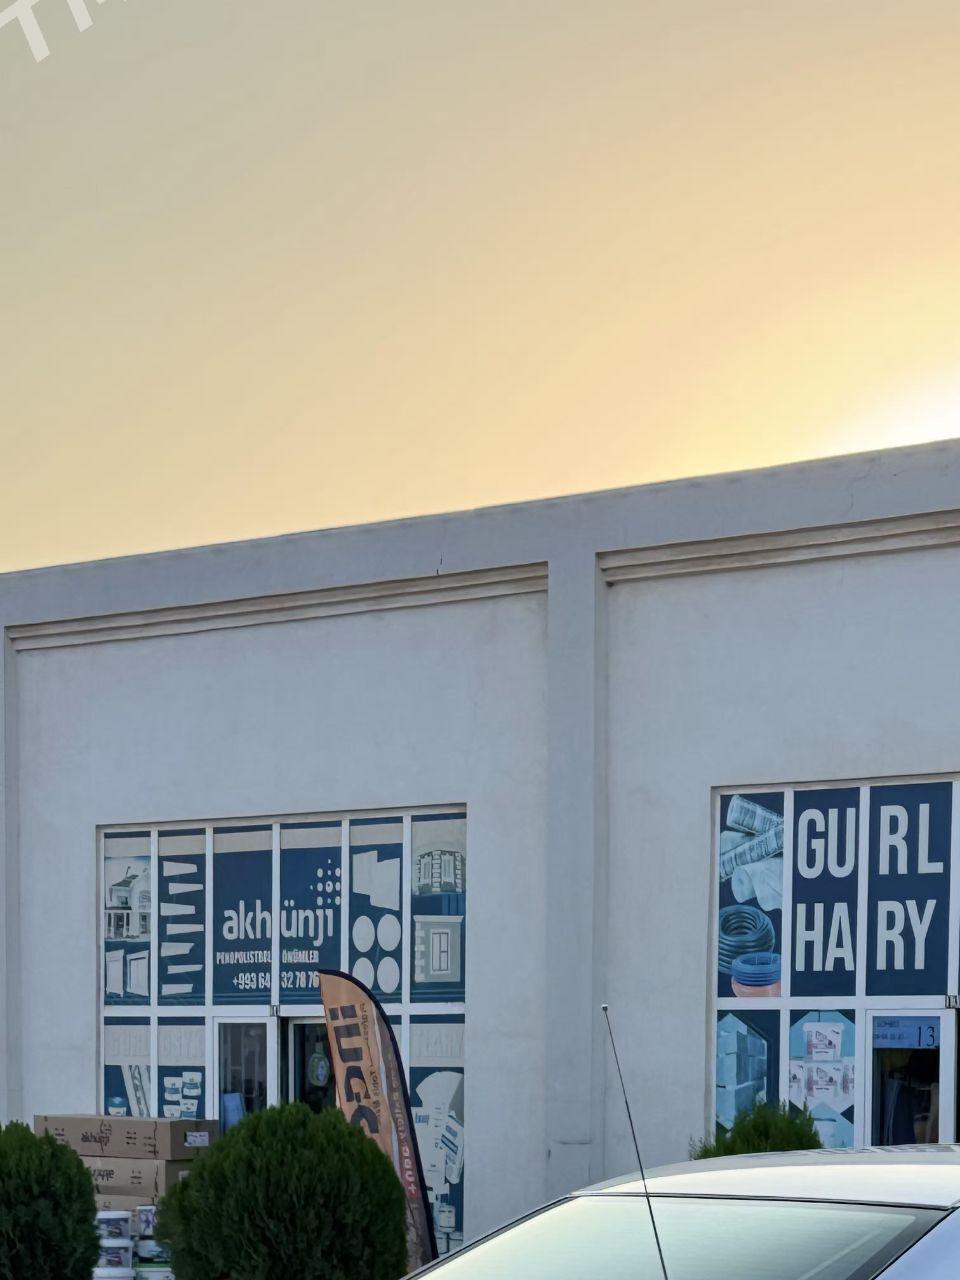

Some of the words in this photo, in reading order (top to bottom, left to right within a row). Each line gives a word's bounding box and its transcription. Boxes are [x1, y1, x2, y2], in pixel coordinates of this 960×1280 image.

[233, 973, 257, 989] +993
[281, 971, 294, 989] 32
[917, 1025, 935, 1047] 13
